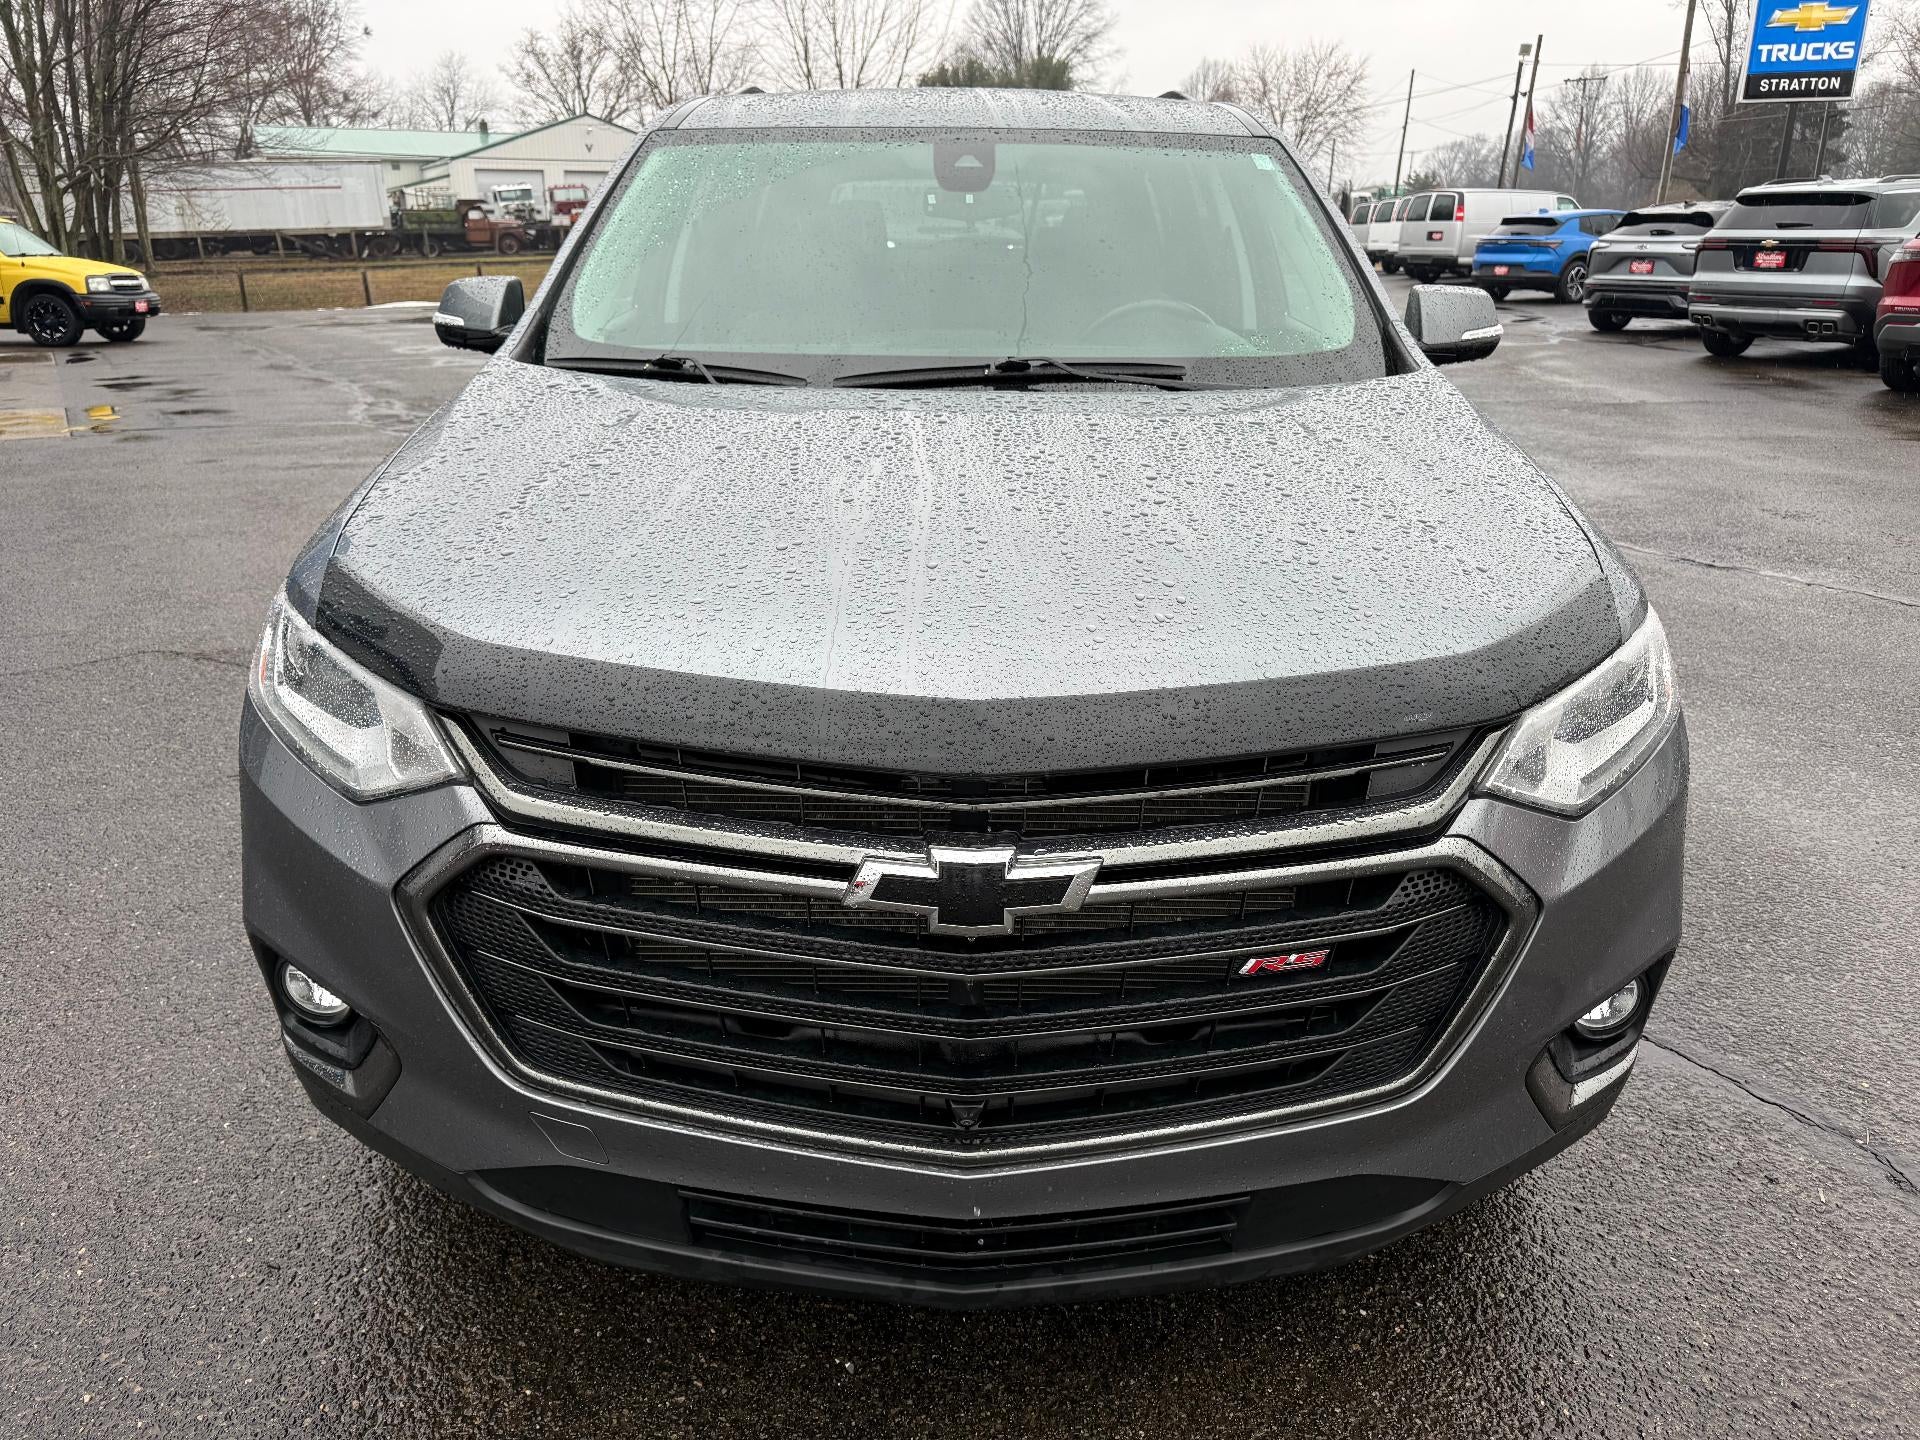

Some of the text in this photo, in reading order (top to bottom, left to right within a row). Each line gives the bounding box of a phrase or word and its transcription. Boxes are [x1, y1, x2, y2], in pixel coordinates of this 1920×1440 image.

[1757, 41, 1856, 63] TRUCKS
[1759, 76, 1841, 92] STRATTON
[1238, 949, 1330, 975] RS
